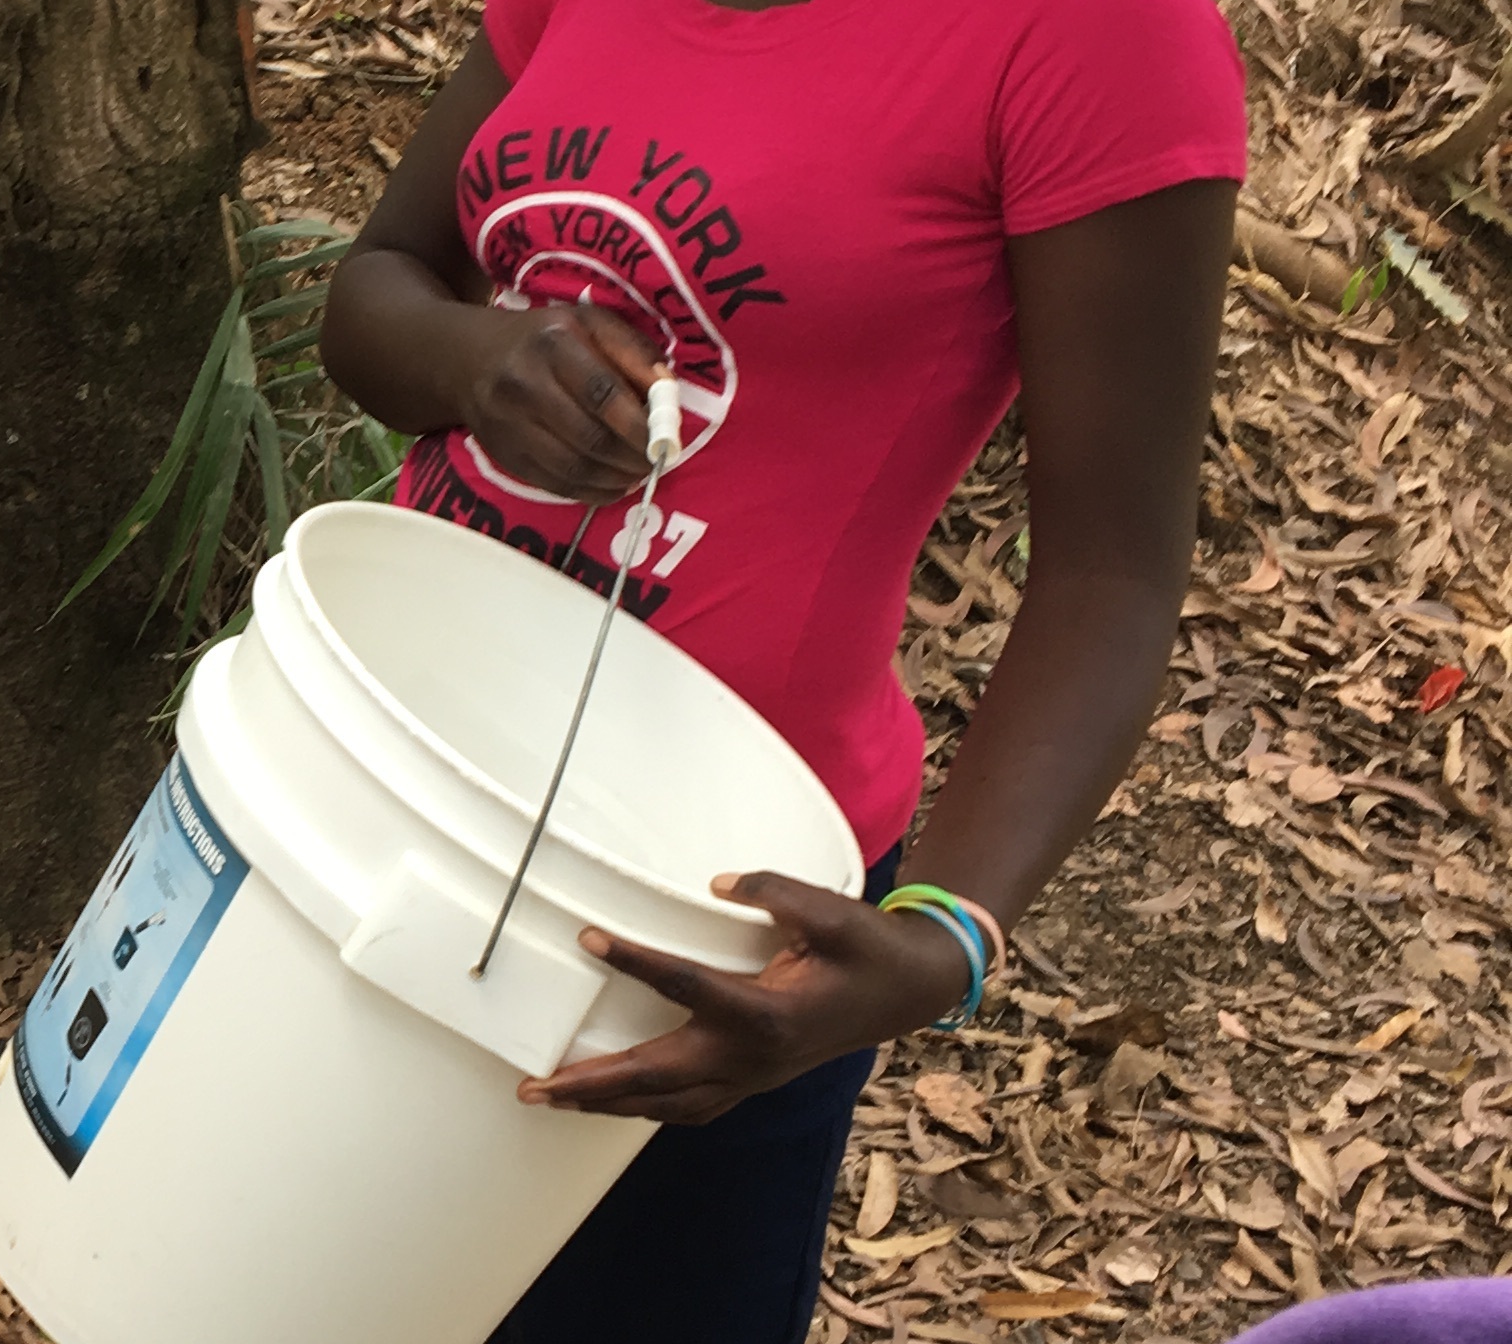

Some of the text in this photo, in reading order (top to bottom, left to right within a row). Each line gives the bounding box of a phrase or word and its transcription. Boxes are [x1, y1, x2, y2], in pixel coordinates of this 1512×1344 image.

[458, 126, 788, 322] NEW YORK
[550, 207, 651, 280] YORK
[654, 286, 721, 386] CITY
[610, 502, 709, 579] 87
